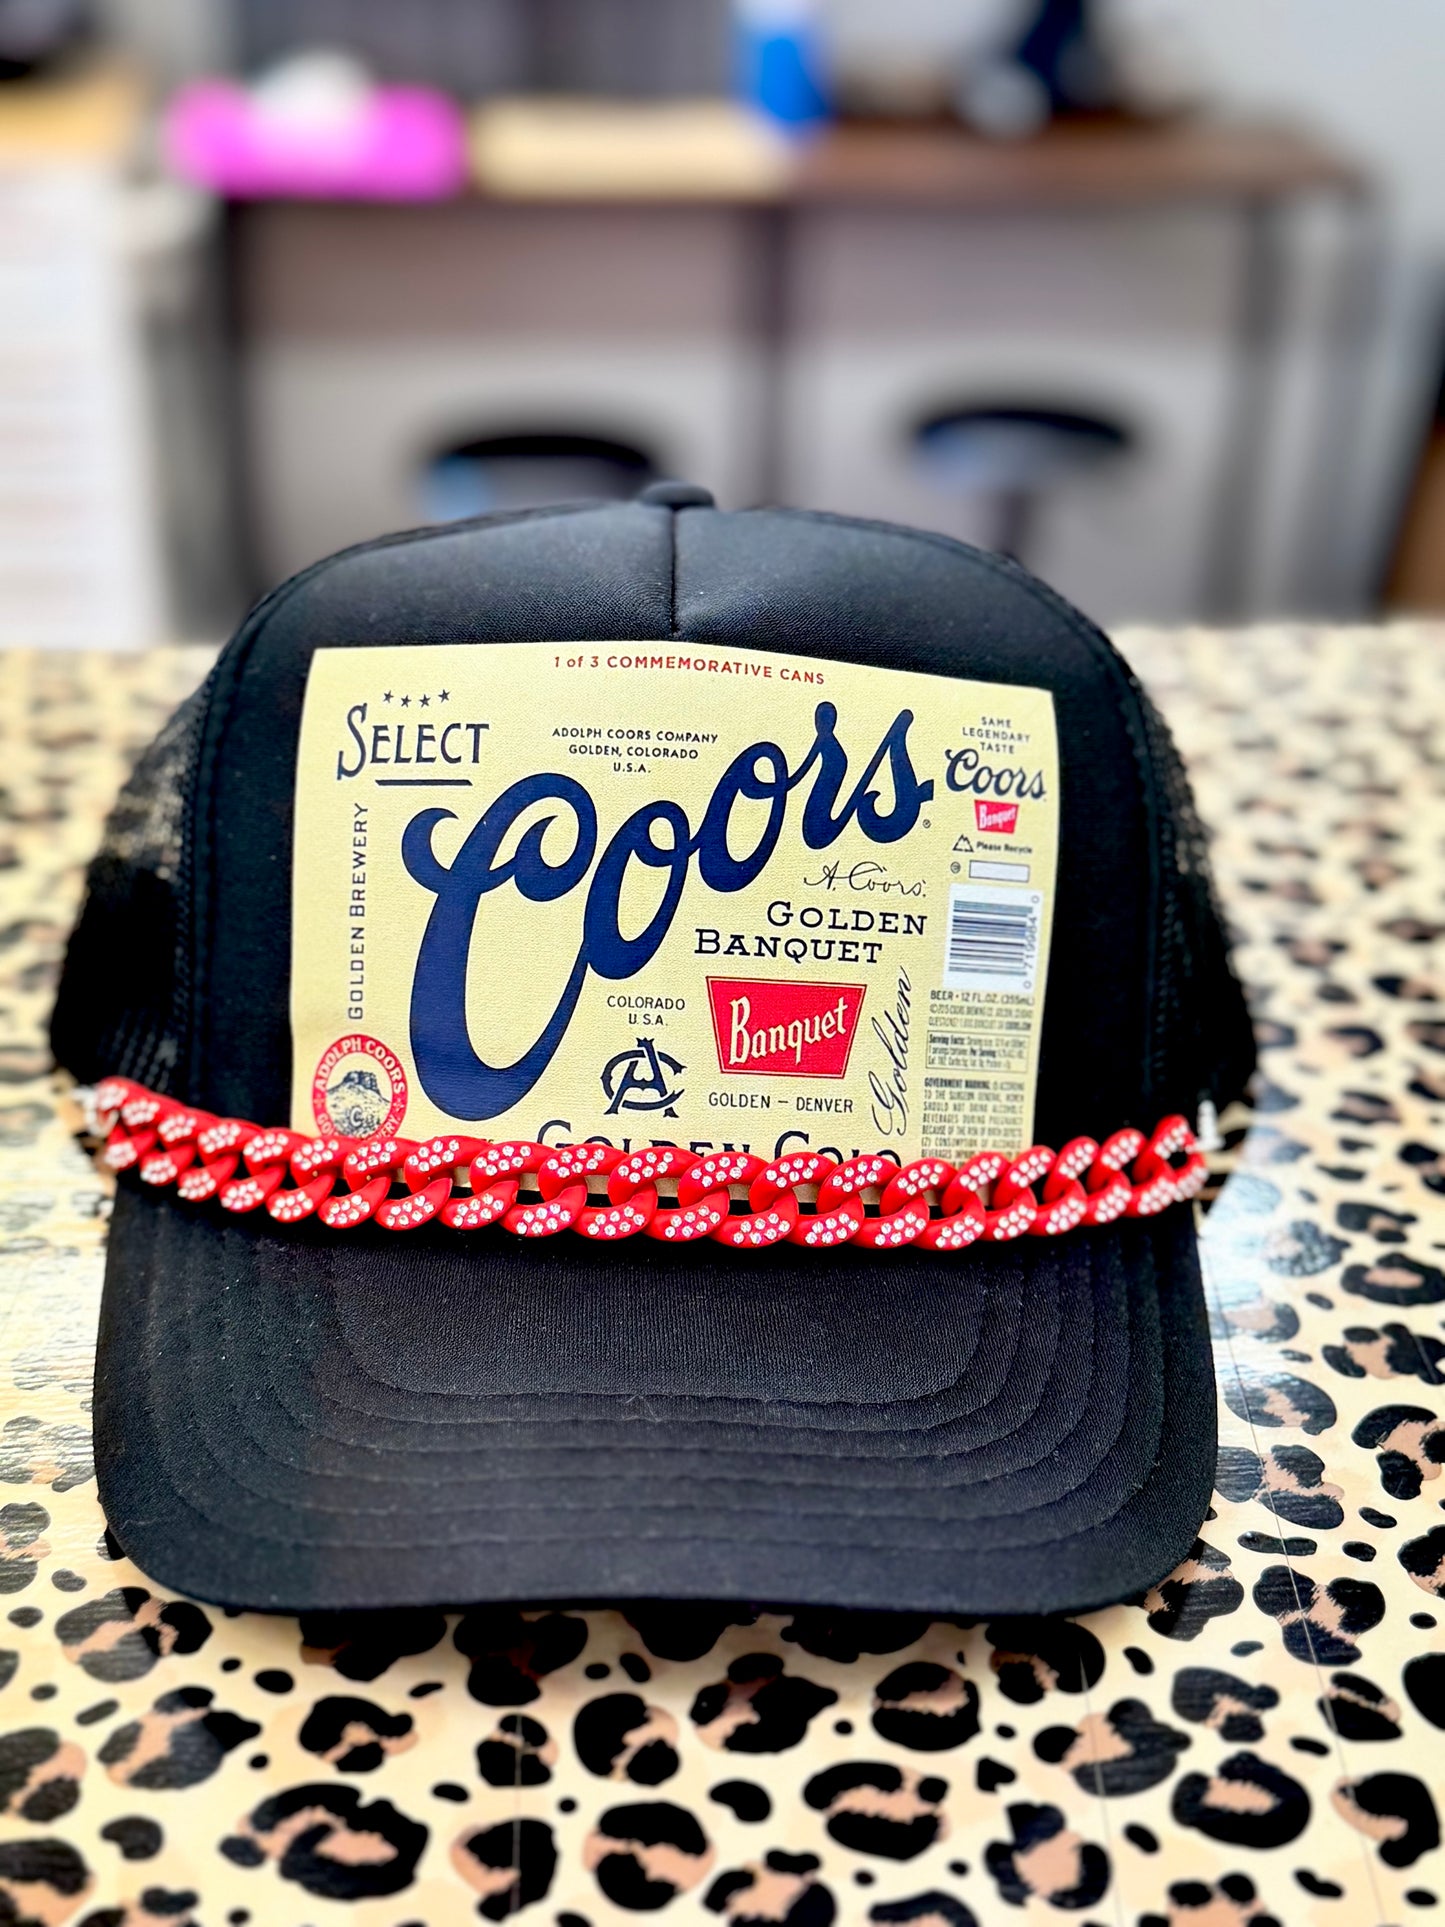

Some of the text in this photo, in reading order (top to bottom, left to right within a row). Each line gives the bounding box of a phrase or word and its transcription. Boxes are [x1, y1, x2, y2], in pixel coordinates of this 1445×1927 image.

[553, 655, 825, 685] 1 of 3 COMMEMORATIVE CANS
[981, 716, 1012, 728] SAME
[336, 703, 490, 781] SELECT
[552, 727, 719, 744] ADOLPH COORS COMPANY
[962, 727, 1031, 742] LEGENDARY
[568, 744, 699, 759] GOLDEN, COLORADO
[980, 741, 1015, 754] TASTE
[613, 762, 651, 773] U.S.A.
[944, 748, 1047, 799] Coors
[976, 841, 1001, 852] Please
[348, 803, 369, 1020] GOLDEN BREWERY
[401, 700, 935, 1122] Coors
[766, 900, 928, 936] GOLDEN
[694, 928, 883, 964] BANQUET
[606, 995, 686, 1011] COLORADO
[930, 989, 954, 1001] BEER
[960, 992, 970, 1002] 12
[628, 1013, 669, 1026] U.S.A.
[728, 995, 849, 1065] Banquet
[868, 965, 912, 1136] Golden
[314, 1036, 406, 1095] ADOLPH COORS
[708, 1092, 771, 1109] GOLDEN
[796, 1096, 853, 1114] DENVER
